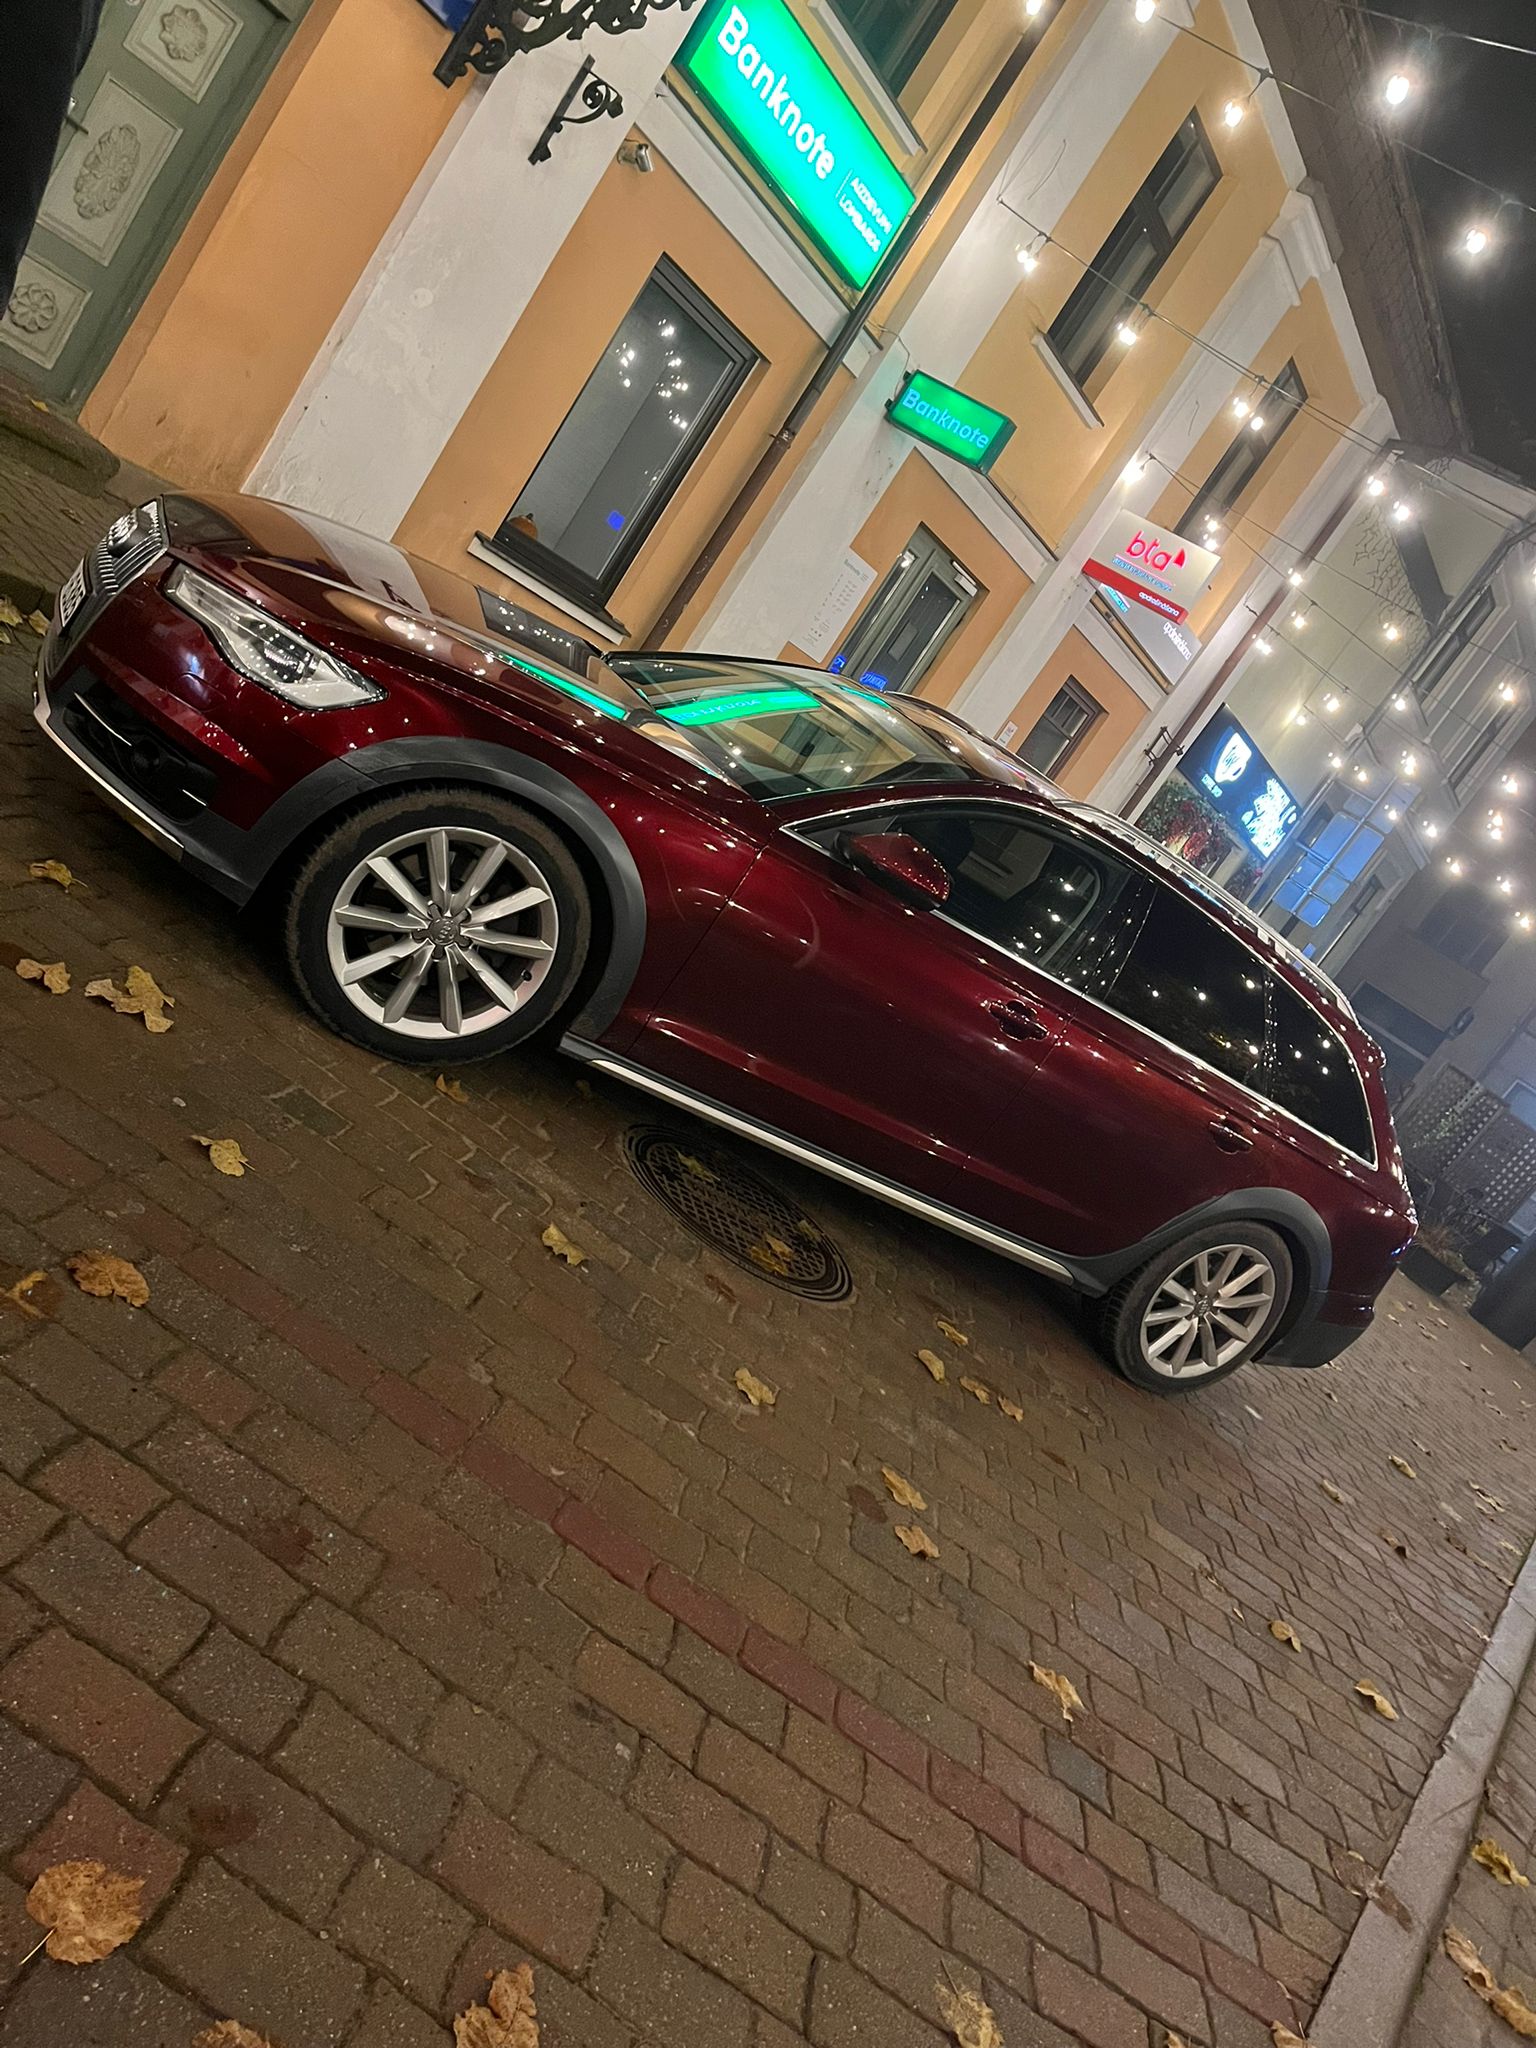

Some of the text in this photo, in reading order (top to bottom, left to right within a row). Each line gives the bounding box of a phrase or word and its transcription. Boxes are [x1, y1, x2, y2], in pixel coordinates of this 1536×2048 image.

[717, 5, 835, 180] Banknote
[902, 389, 989, 448] Banknote
[1125, 530, 1173, 572] bta
